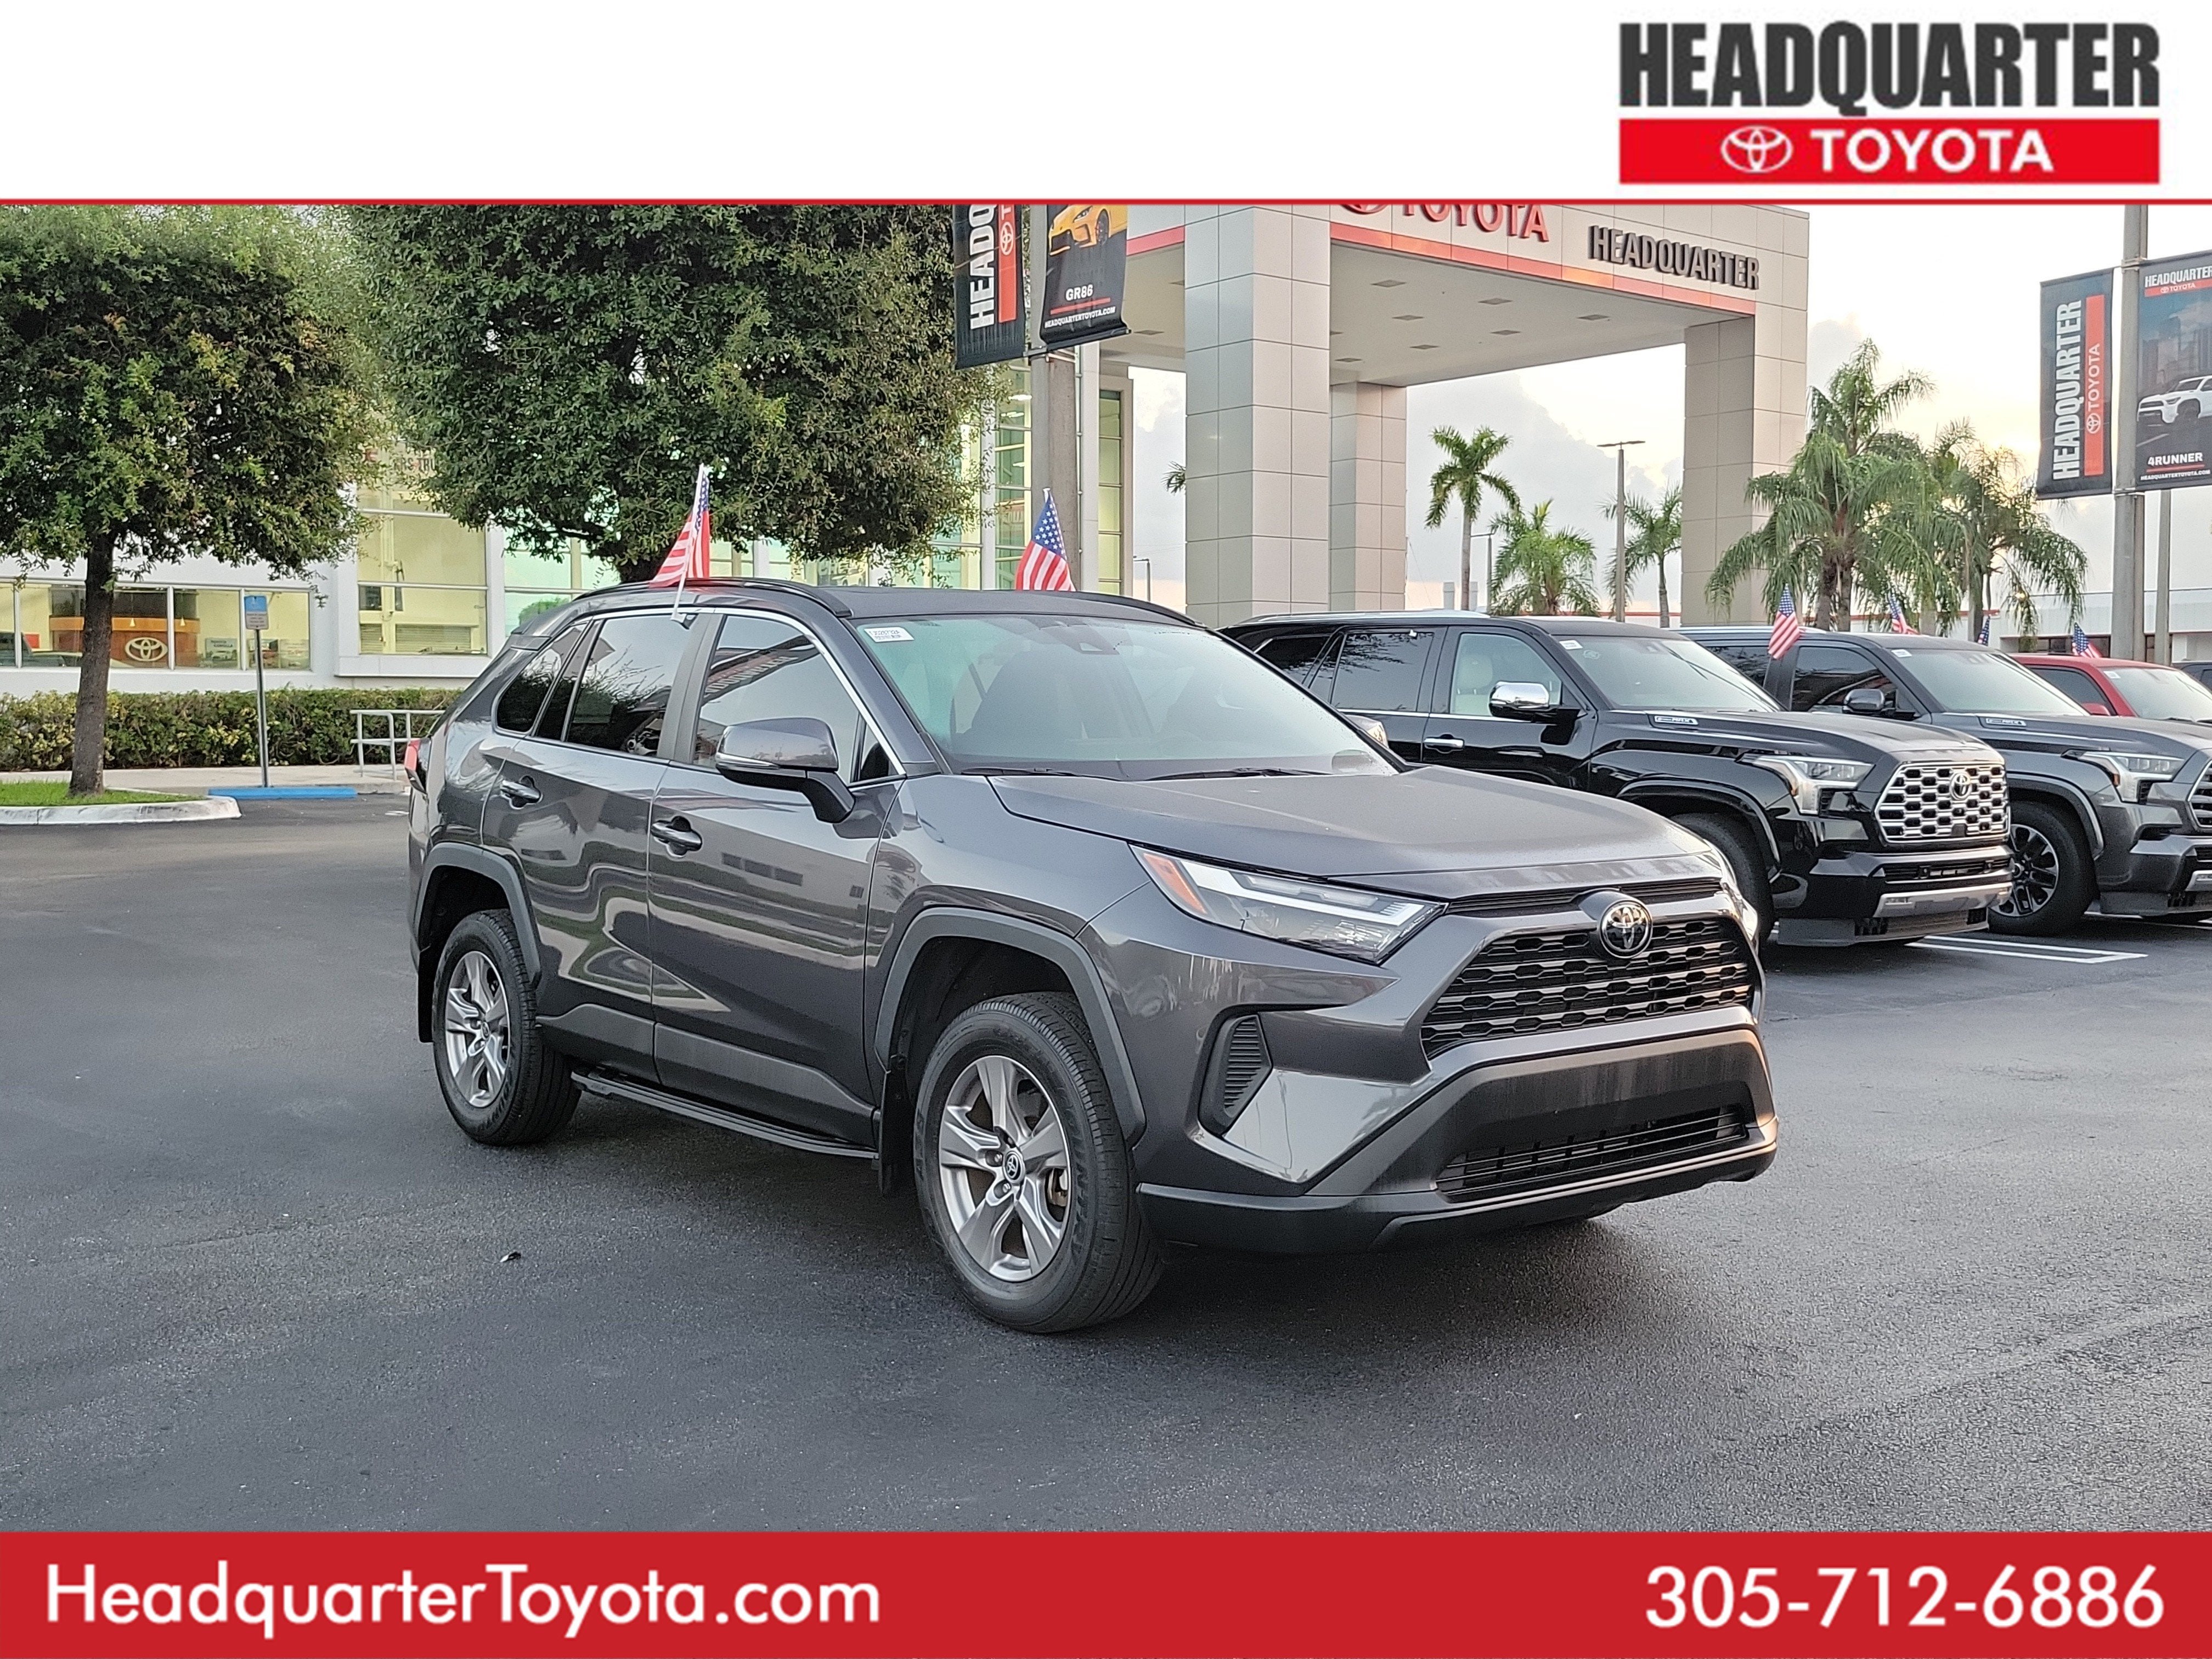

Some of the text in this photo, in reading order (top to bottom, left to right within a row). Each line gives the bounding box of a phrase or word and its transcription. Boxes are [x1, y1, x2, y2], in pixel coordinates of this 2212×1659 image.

[1587, 225, 1759, 290] HEADQUARTER
[1065, 284, 1094, 301] GR86
[2169, 283, 2196, 292] TOYOTA
[2052, 299, 2084, 481] HEADQUARTER
[2087, 343, 2101, 411] TOYOTA
[2147, 452, 2203, 466] 4RUNNER
